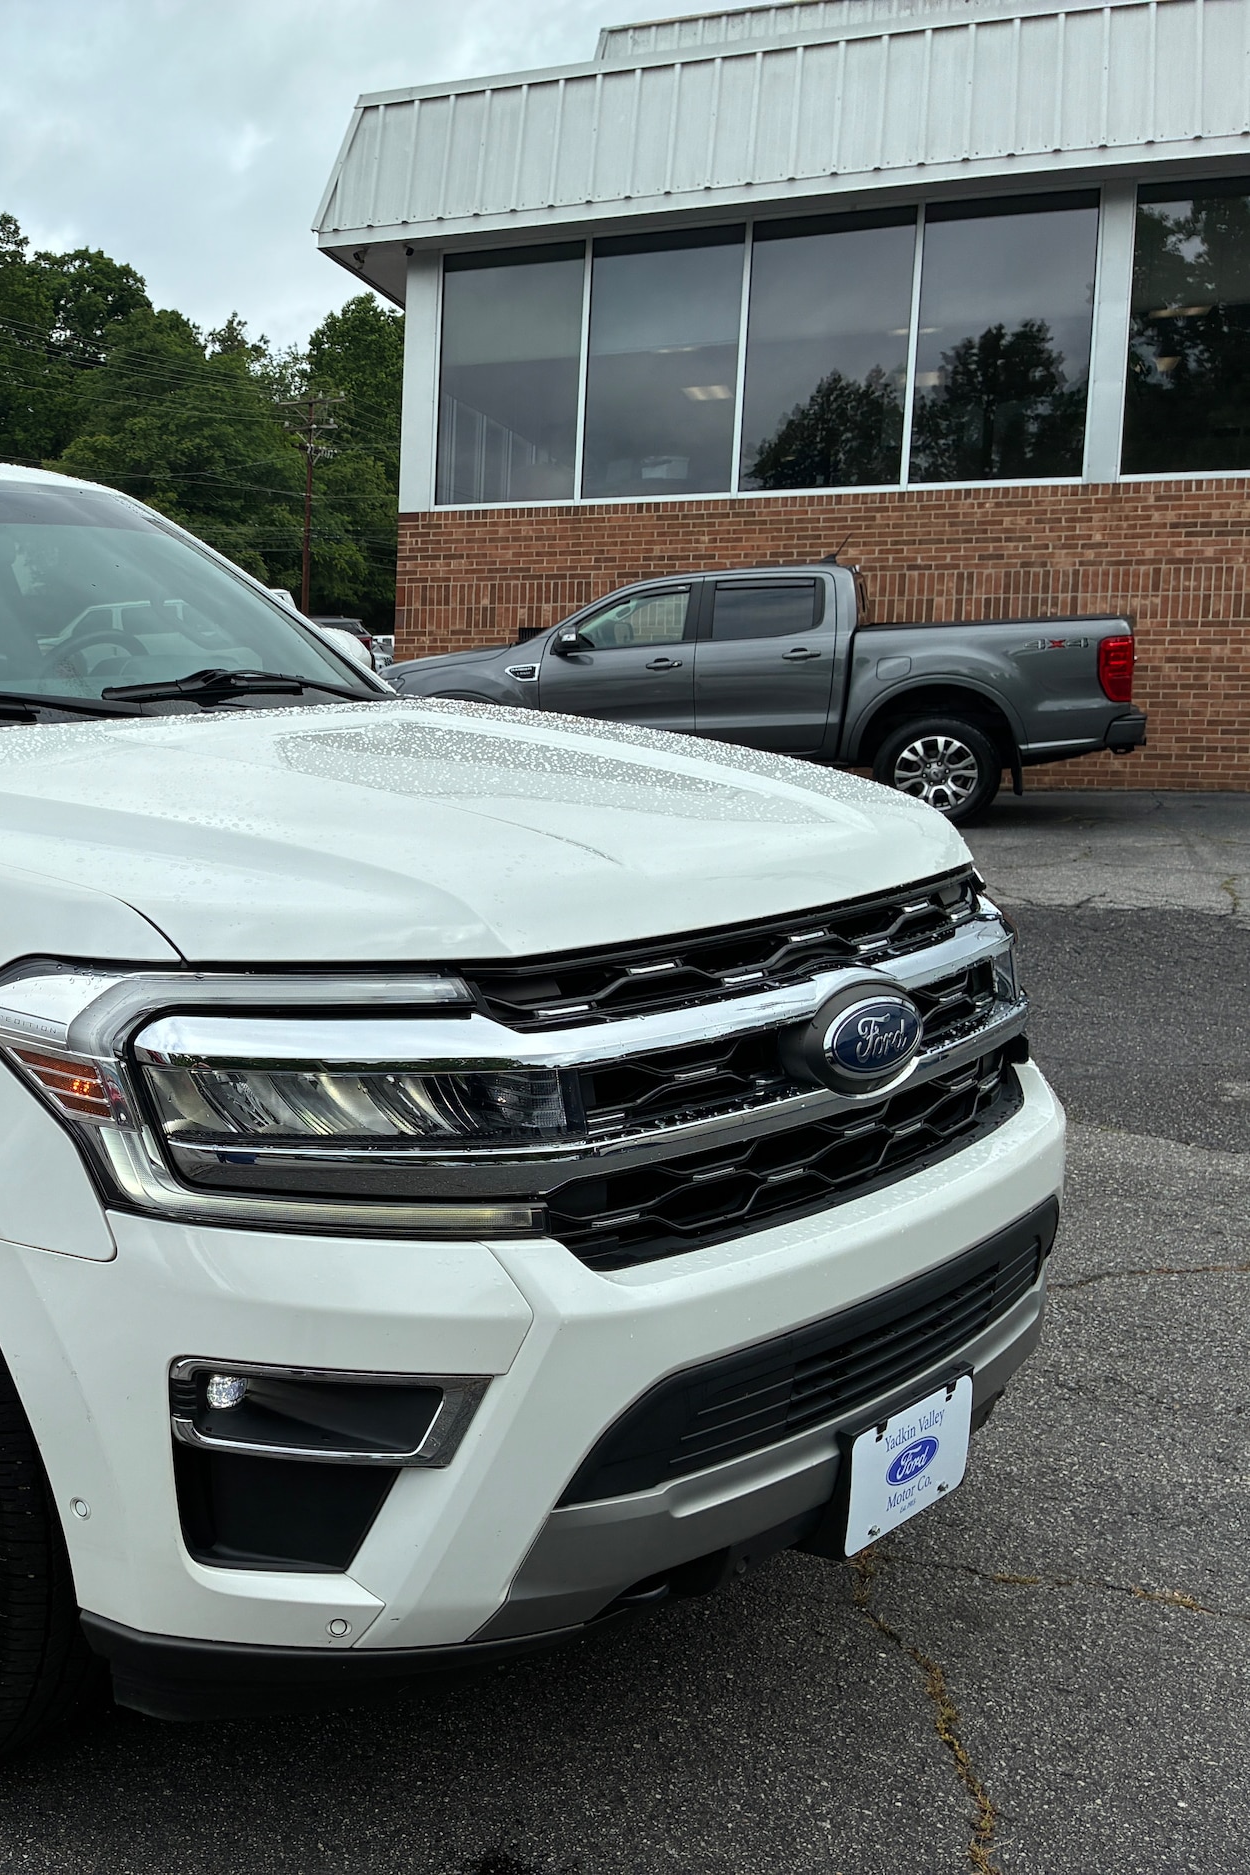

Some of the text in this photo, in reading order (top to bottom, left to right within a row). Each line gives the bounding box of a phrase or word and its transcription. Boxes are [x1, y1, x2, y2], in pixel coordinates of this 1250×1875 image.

[856, 1013, 907, 1063] Ford
[884, 1409, 945, 1452] Yadkin Valley
[896, 1444, 930, 1480] Ford
[886, 1485, 916, 1512] Motor
[917, 1475, 932, 1491] Co.
